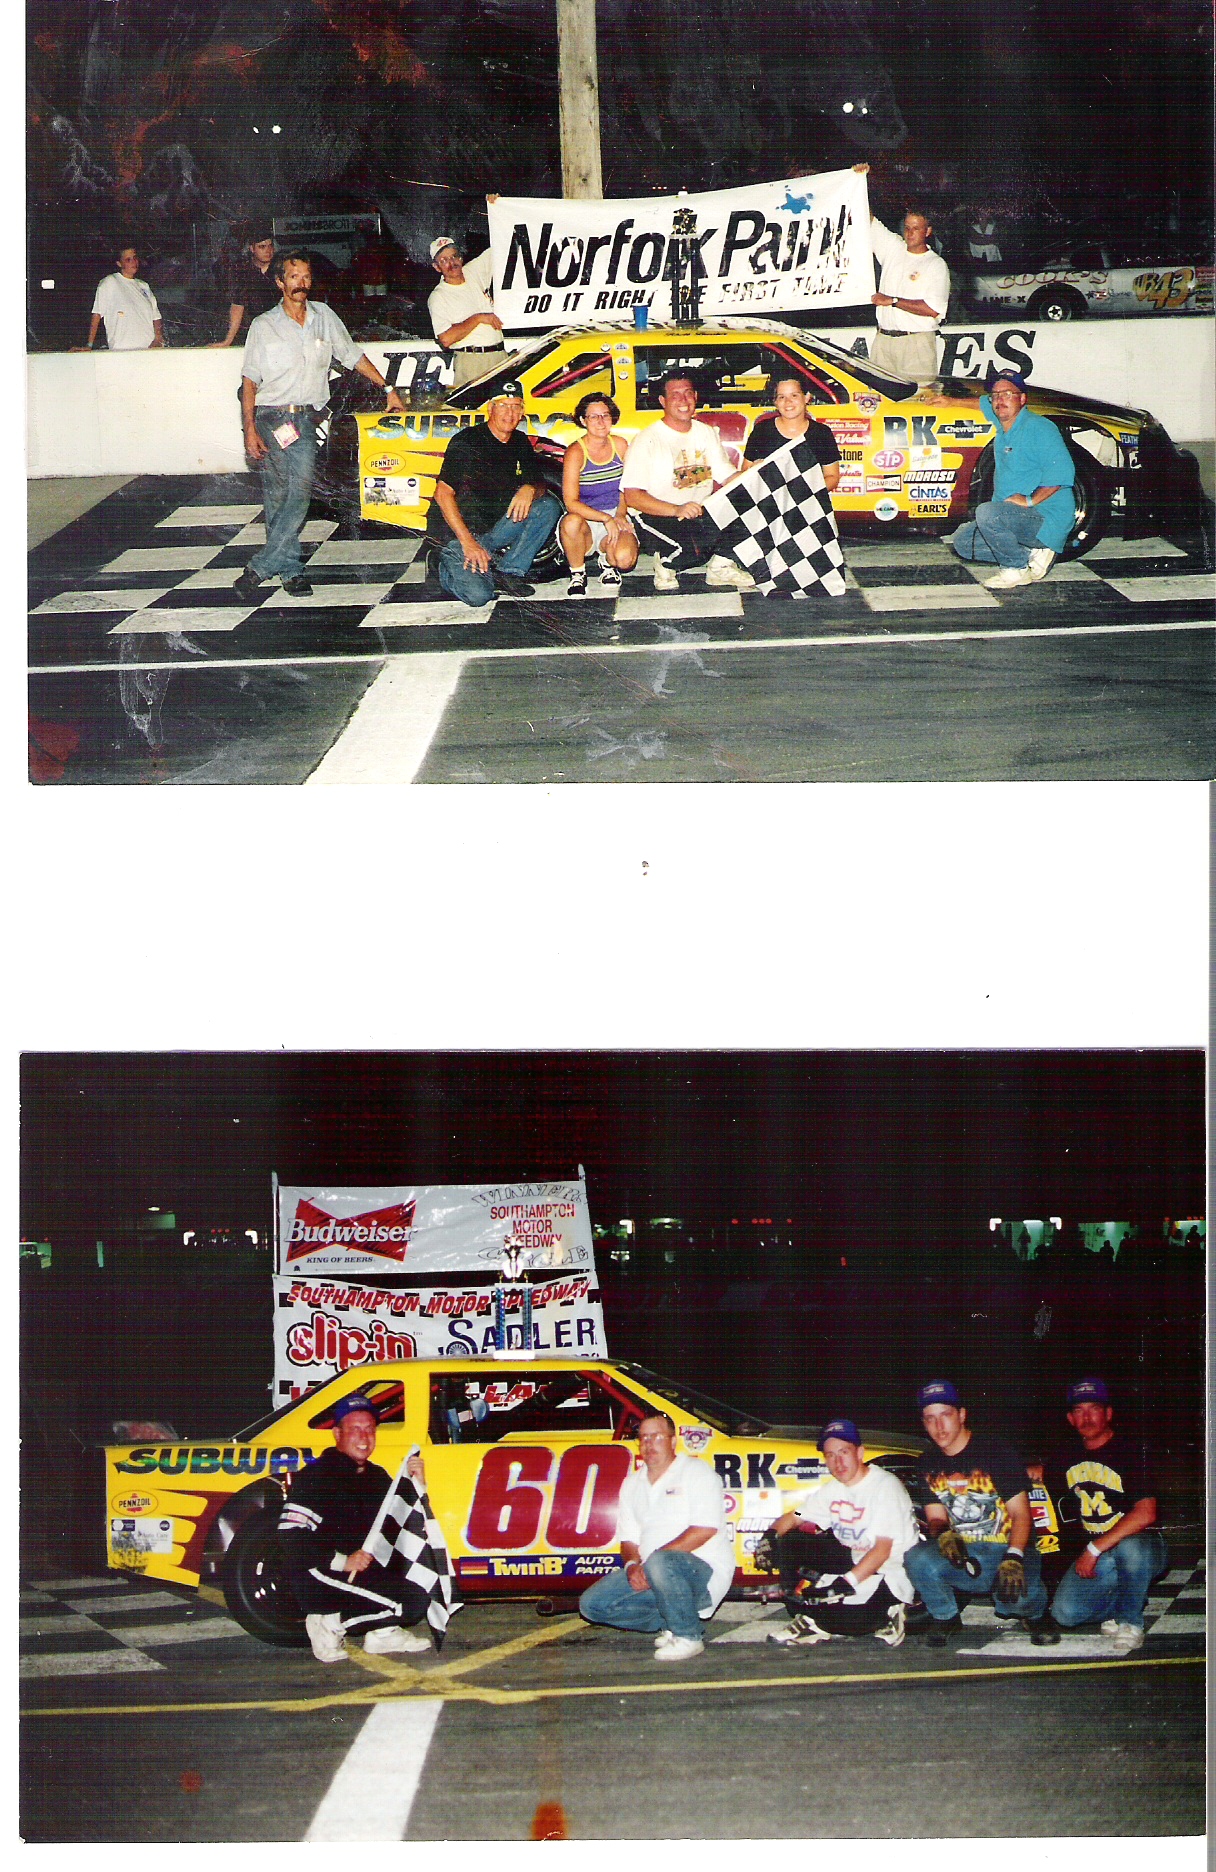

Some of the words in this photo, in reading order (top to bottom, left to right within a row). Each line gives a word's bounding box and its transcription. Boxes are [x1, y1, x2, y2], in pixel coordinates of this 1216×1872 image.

[523, 293, 551, 315] DO
[562, 292, 585, 312] IT
[883, 415, 938, 446] RK
[944, 426, 983, 434] Chevrolet
[370, 459, 400, 471] PENNZOIL
[876, 453, 901, 468] STP
[867, 480, 900, 488] CHAMPION
[904, 471, 956, 483] MOROSO
[917, 504, 947, 514] EARL'S
[489, 1203, 576, 1220] SOUTHAMPTON
[284, 1218, 418, 1244] Budweiser
[512, 1219, 553, 1235] MOTOR
[287, 1283, 420, 1313] SOUTHAMPTON
[426, 1293, 491, 1315] MOTOR
[288, 1311, 417, 1372] slip-in
[447, 1318, 598, 1355] SADLER
[713, 1454, 776, 1489] RK
[118, 1498, 152, 1509] PENNZOIL
[465, 1445, 633, 1551] 60
[575, 1557, 615, 1565] AUTO
